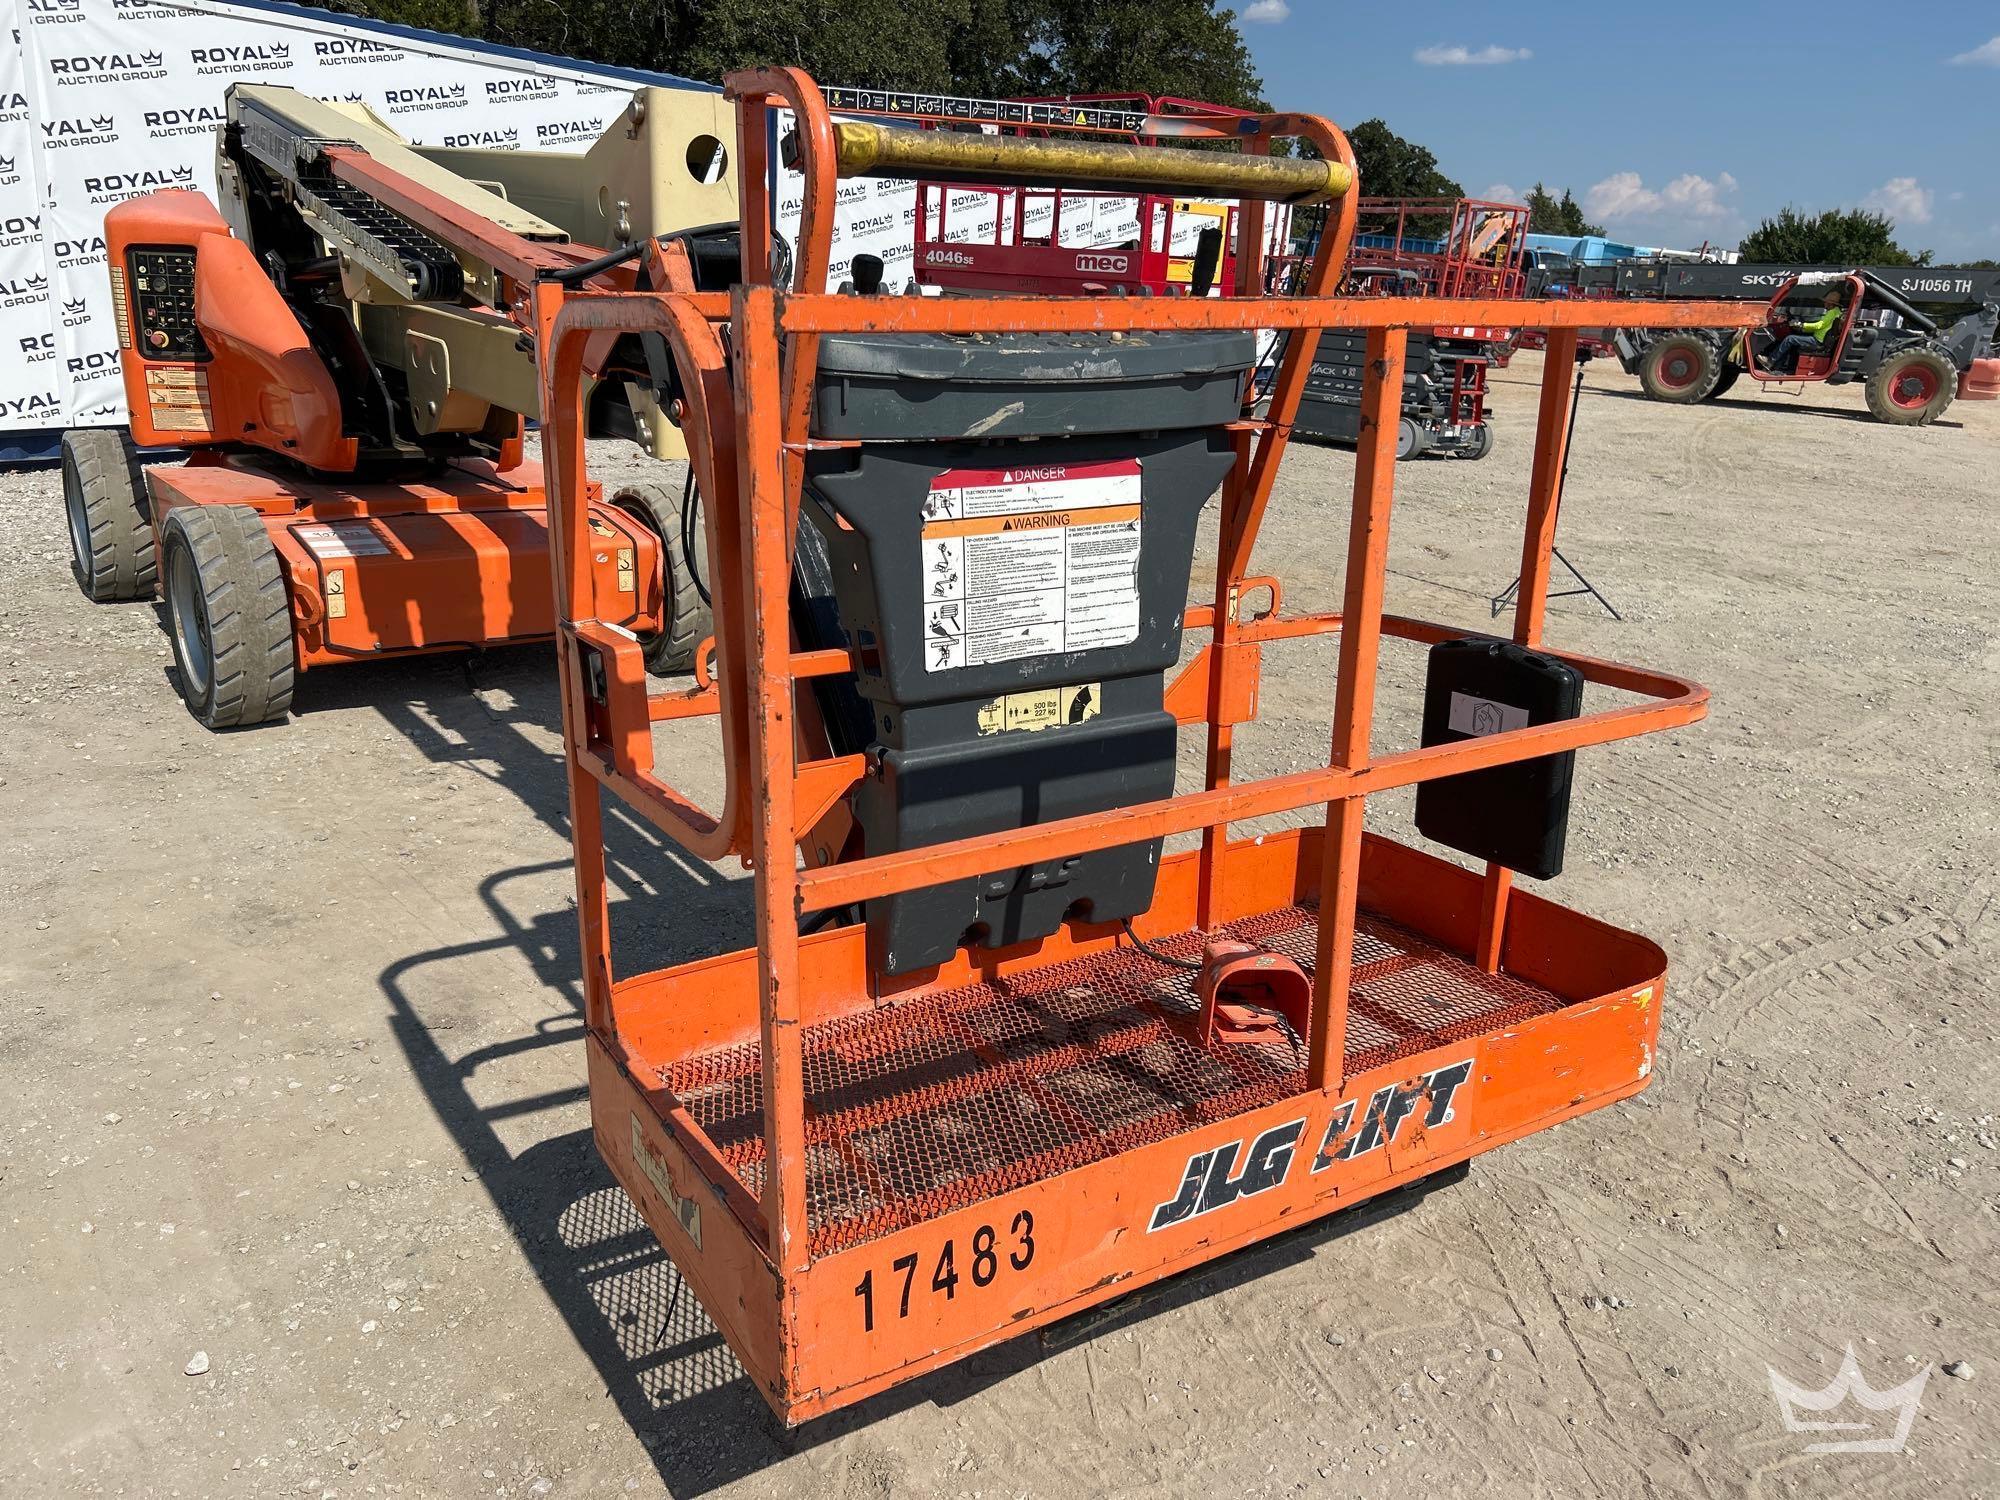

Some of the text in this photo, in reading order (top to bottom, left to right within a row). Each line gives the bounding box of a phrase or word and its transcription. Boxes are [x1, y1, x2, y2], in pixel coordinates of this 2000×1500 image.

[35, 14, 86, 24] GROUP
[117, 10, 176, 20] AUCTION
[191, 45, 271, 63] ROYAL
[314, 39, 385, 55] ROYAL
[50, 54, 142, 73] ROYAL
[319, 53, 405, 66] AUCTION GROUP
[197, 61, 294, 75] AUCTION GROUP
[57, 70, 168, 86] AUCTION GROUP
[485, 78, 543, 95] ROYAL
[385, 86, 450, 104] ROYAL
[488, 91, 559, 104] AUCTION GROUP
[389, 100, 469, 114] AUCTION GROUP
[144, 106, 227, 127] ROYAL
[41, 119, 93, 136] YAL
[150, 126, 206, 138] AUCTION
[537, 121, 590, 137] ROYAL
[70, 134, 119, 147] GROUP
[443, 131, 504, 147] ROYAL
[539, 132, 604, 146] AUCTION GROUP
[84, 170, 173, 193] ROYAL
[90, 190, 150, 204] AUCTION
[837, 187, 857, 198] YAL
[781, 199, 801, 211] YAL
[951, 194, 980, 207] ROYAL
[1100, 199, 1120, 210] ROYAL
[1025, 207, 1044, 219] OYAL
[851, 217, 884, 231] ROYAL
[977, 221, 995, 232] ROY
[1076, 221, 1093, 232] ROYA
[1118, 220, 1138, 232] ROYAL
[1094, 231, 1106, 240] YAL
[1172, 231, 1183, 240] YAL
[882, 243, 914, 258] ROYAL
[926, 250, 974, 265] 4046SE
[57, 255, 101, 269] CTION
[829, 260, 851, 273] ROY
[1077, 256, 1126, 271] mec
[1626, 270, 1632, 278] A
[1901, 279, 1973, 293] SJ1056 TH
[63, 315, 92, 327] OUP
[67, 350, 119, 373] ROY
[72, 366, 121, 383] AUCTIO
[1311, 363, 1336, 376] JACK
[1015, 467, 1066, 481] DANGER
[1014, 514, 1070, 530] WARNING
[1034, 702, 1045, 710] 500
[1035, 709, 1046, 717] 227
[1146, 1117, 1309, 1234] JLG
[855, 1210, 1036, 1333] 17483
